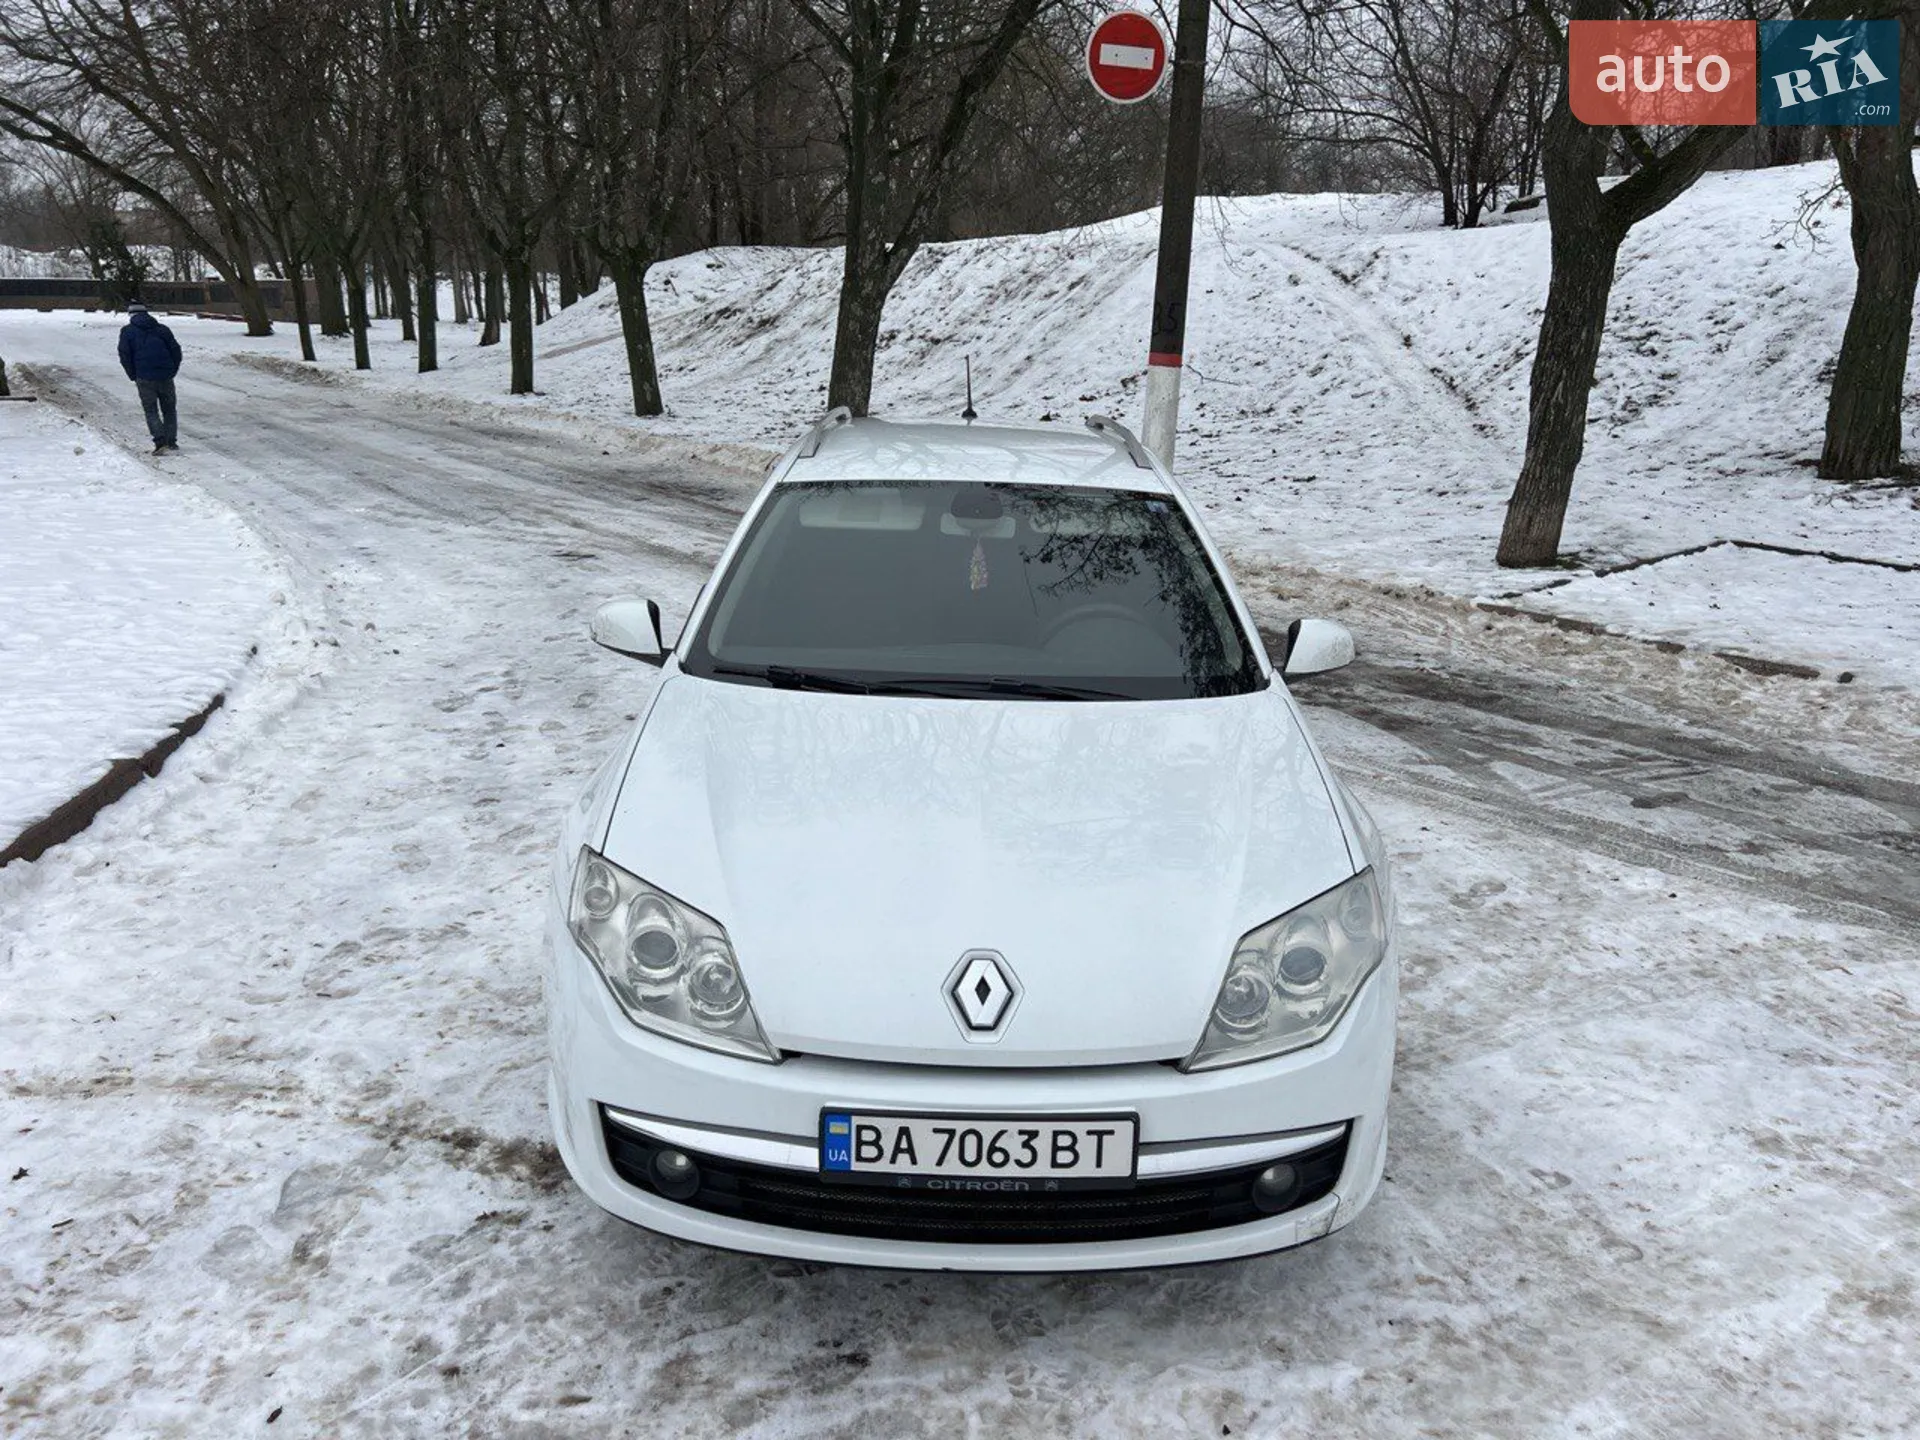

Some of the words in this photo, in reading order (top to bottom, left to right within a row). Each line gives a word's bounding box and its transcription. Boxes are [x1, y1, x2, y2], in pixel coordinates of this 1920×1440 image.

[828, 1149, 848, 1162] UA
[855, 1124, 918, 1165] BA
[932, 1127, 1040, 1169] 7063
[1050, 1129, 1115, 1169] BT
